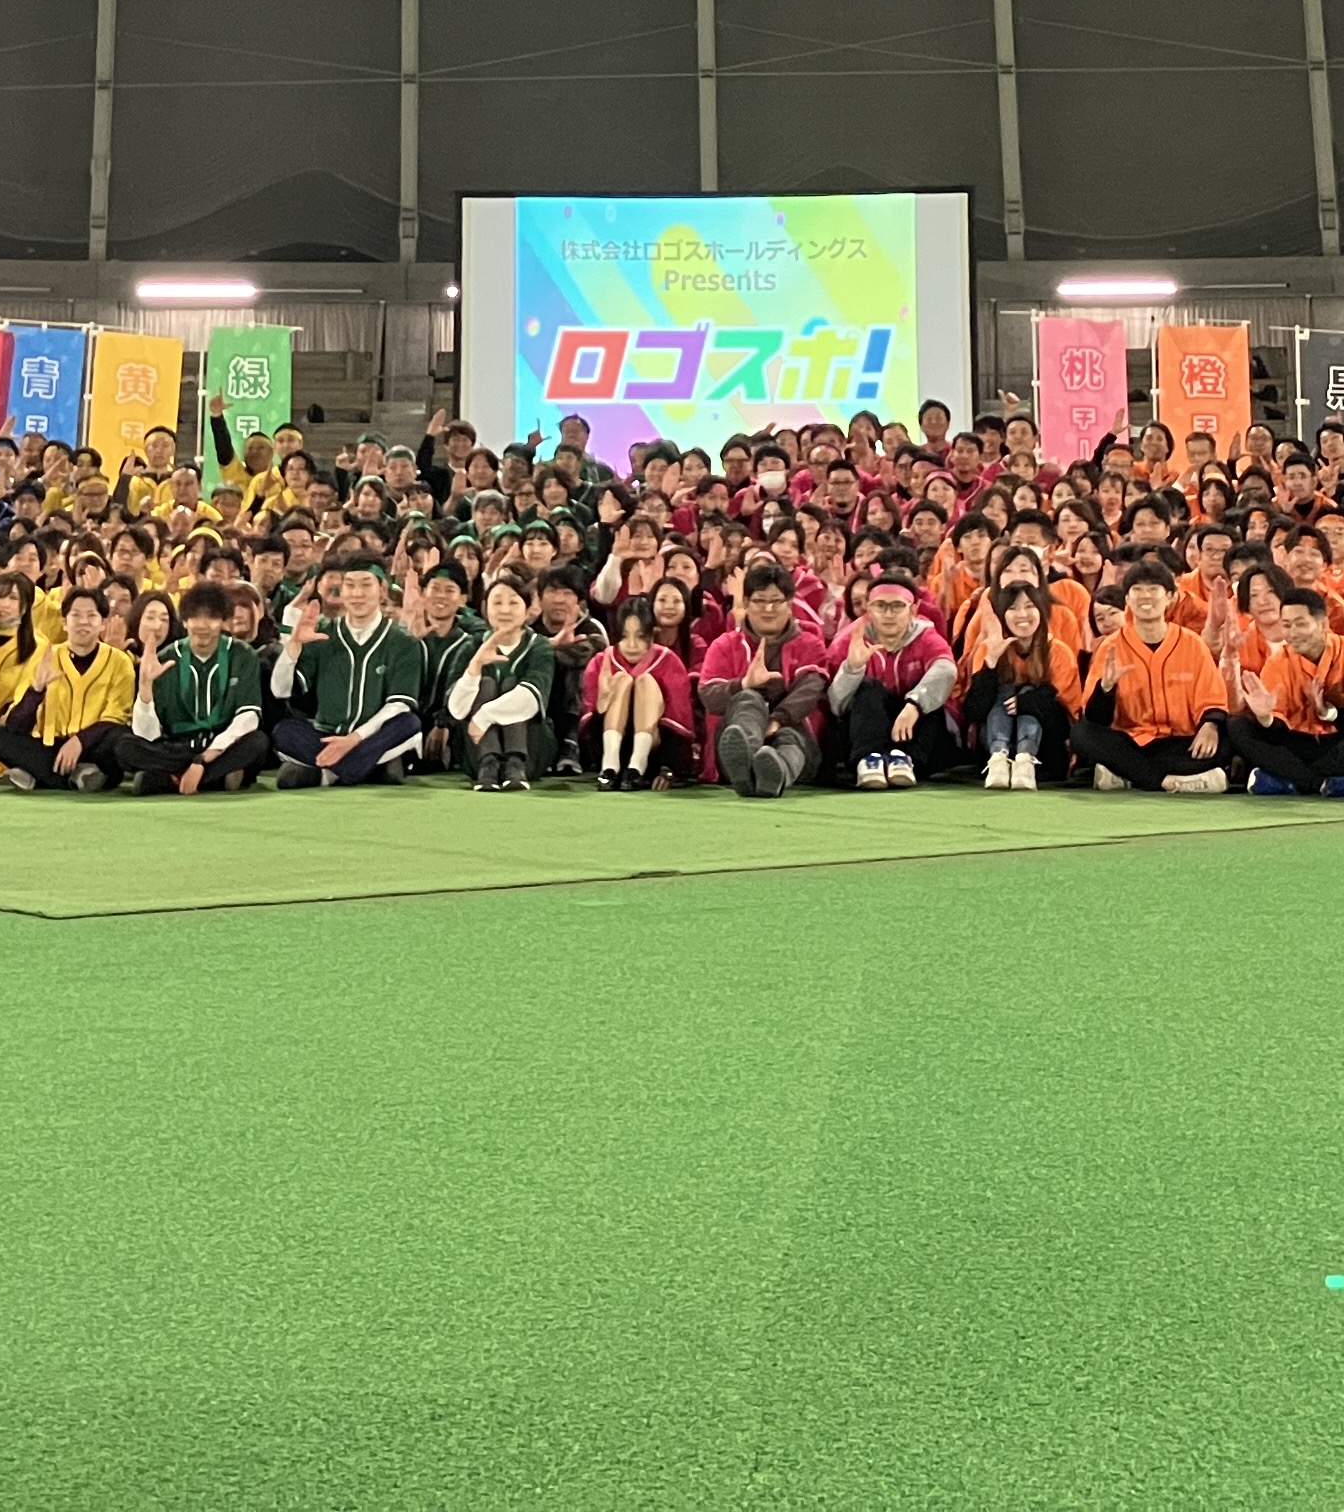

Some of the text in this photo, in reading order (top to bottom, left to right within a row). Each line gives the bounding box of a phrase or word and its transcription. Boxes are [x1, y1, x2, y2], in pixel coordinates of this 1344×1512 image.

[561, 238, 868, 261] 株式会社ロゴスホールディングス
[664, 270, 776, 291] Presents
